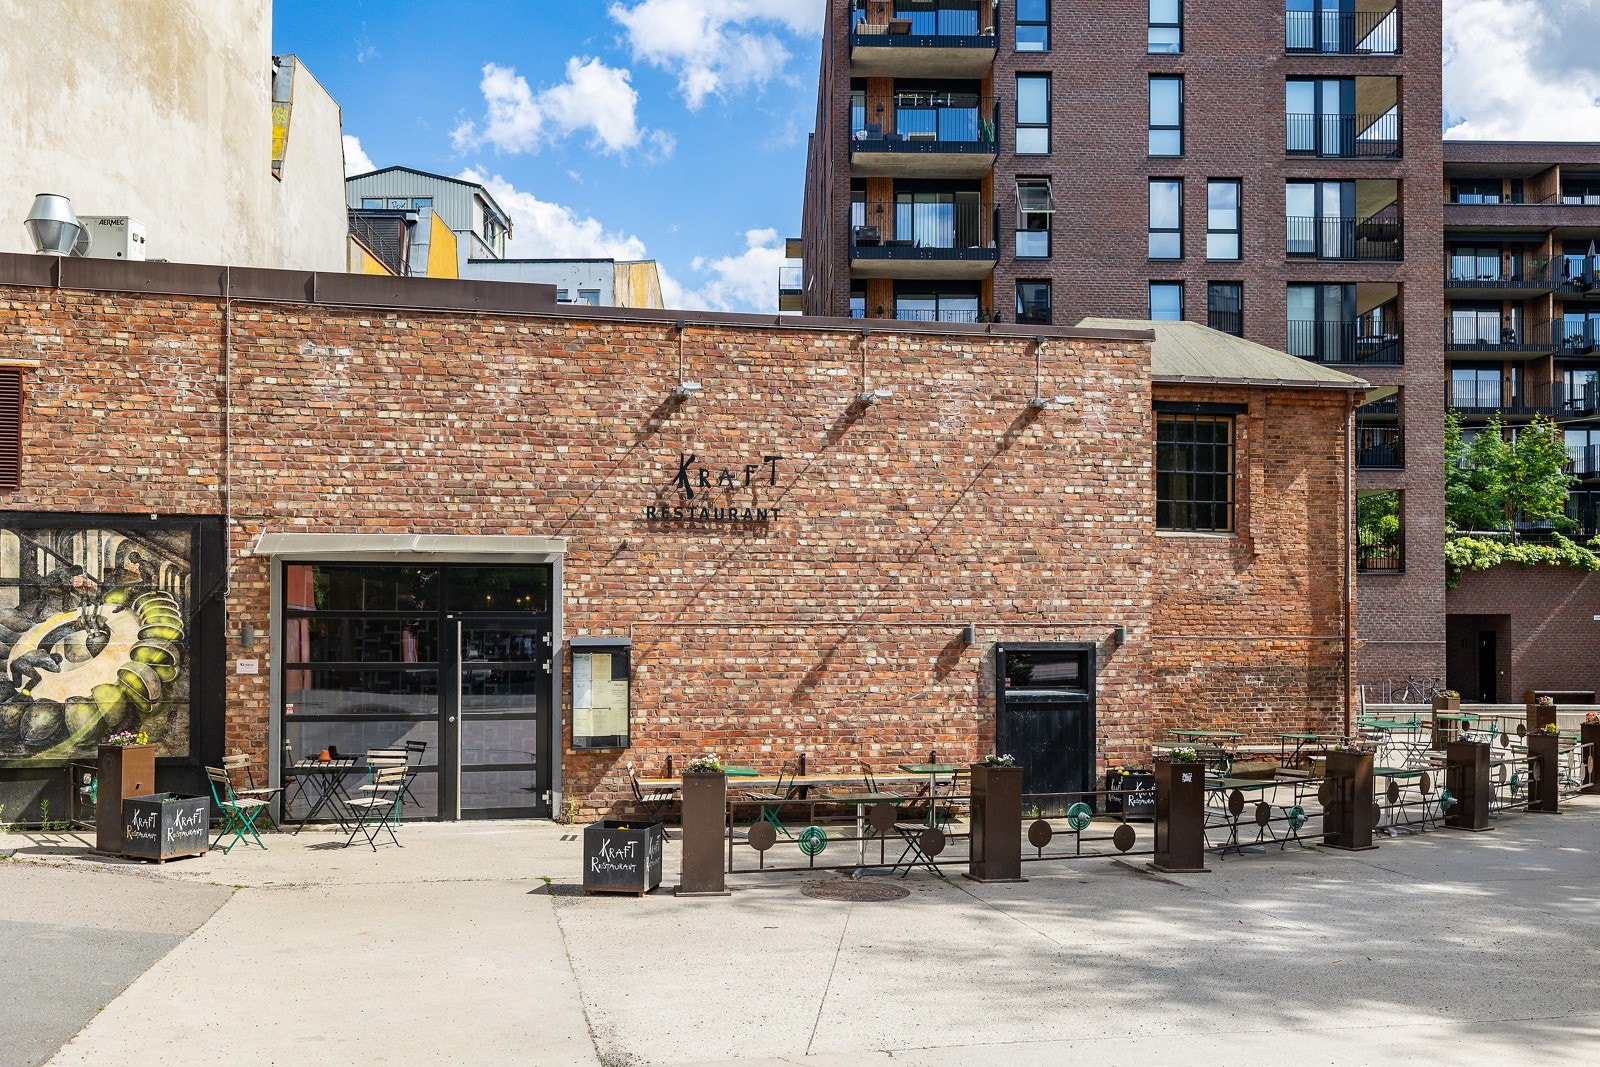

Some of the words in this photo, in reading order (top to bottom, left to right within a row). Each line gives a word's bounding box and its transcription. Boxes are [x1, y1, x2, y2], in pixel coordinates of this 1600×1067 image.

[672, 452, 783, 499] KRAFT
[646, 505, 781, 521] RESTAURANT
[132, 808, 158, 831] KRAFT
[173, 807, 205, 831] KRAFT
[598, 838, 639, 863] KRAFT
